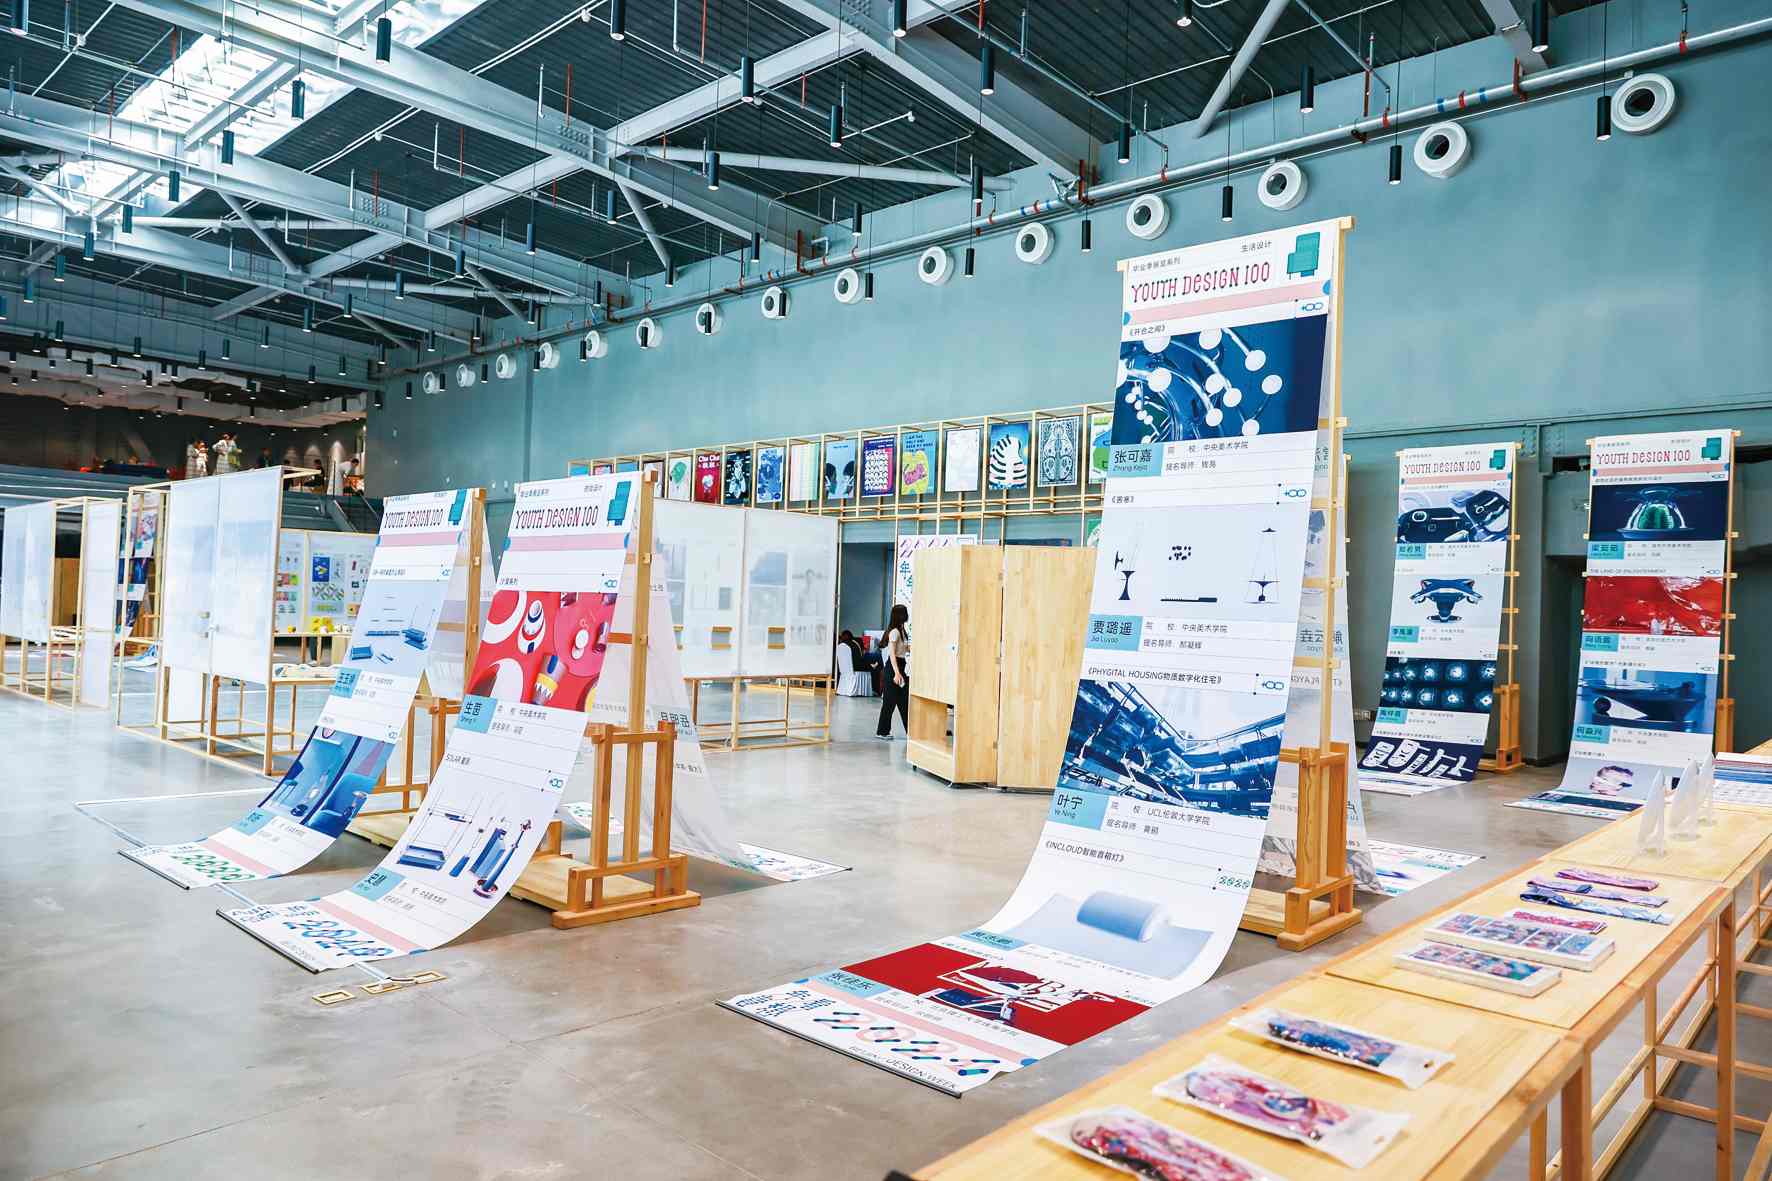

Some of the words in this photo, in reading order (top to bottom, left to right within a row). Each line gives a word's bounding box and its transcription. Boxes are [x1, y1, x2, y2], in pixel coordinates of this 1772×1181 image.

[1241, 240, 1272, 252] 生活设计
[1131, 277, 1177, 303] YOUTH
[1244, 261, 1271, 285] 100
[1113, 449, 1152, 464] 张可嘉
[1597, 452, 1629, 465] YOUTH
[1404, 462, 1431, 474] YOUTH
[384, 510, 405, 530] YOUTH
[515, 509, 544, 530] YOUTH
[1092, 620, 1133, 637] 贾璐遥
[1057, 793, 1083, 811] 叶宁
[886, 1058, 924, 1077] DESIGN
[927, 1074, 956, 1089] WEEK
